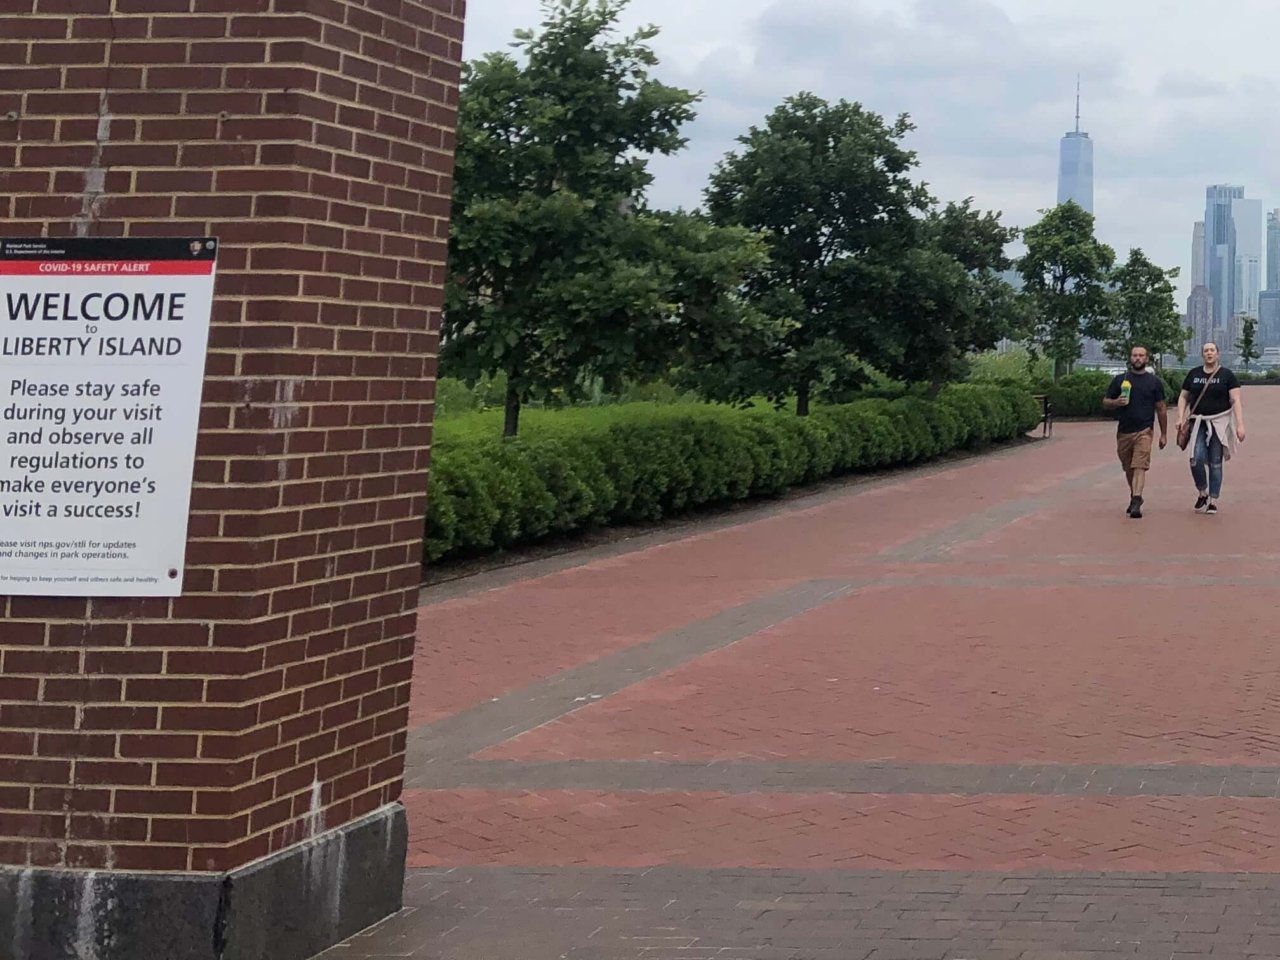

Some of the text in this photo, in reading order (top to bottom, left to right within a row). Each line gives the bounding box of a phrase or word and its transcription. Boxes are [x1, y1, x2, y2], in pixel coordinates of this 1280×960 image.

[39, 263, 150, 272] COVID-19 SAFETY ALERT
[6, 292, 186, 321] WELCOME
[85, 324, 98, 334] to
[2, 337, 182, 356] LIBERTY ISLAND
[10, 378, 161, 401] Please stay safe
[3, 403, 162, 424] during your visit
[7, 427, 154, 445] and observe all
[10, 452, 145, 473] regulations to
[51, 477, 156, 498] everyone's
[3, 500, 141, 518] visit a success!
[20, 540, 36, 548] visit
[88, 540, 100, 548] for
[103, 541, 136, 550] updates
[14, 551, 48, 560] changes
[60, 552, 79, 560] park
[82, 552, 129, 560] operations.
